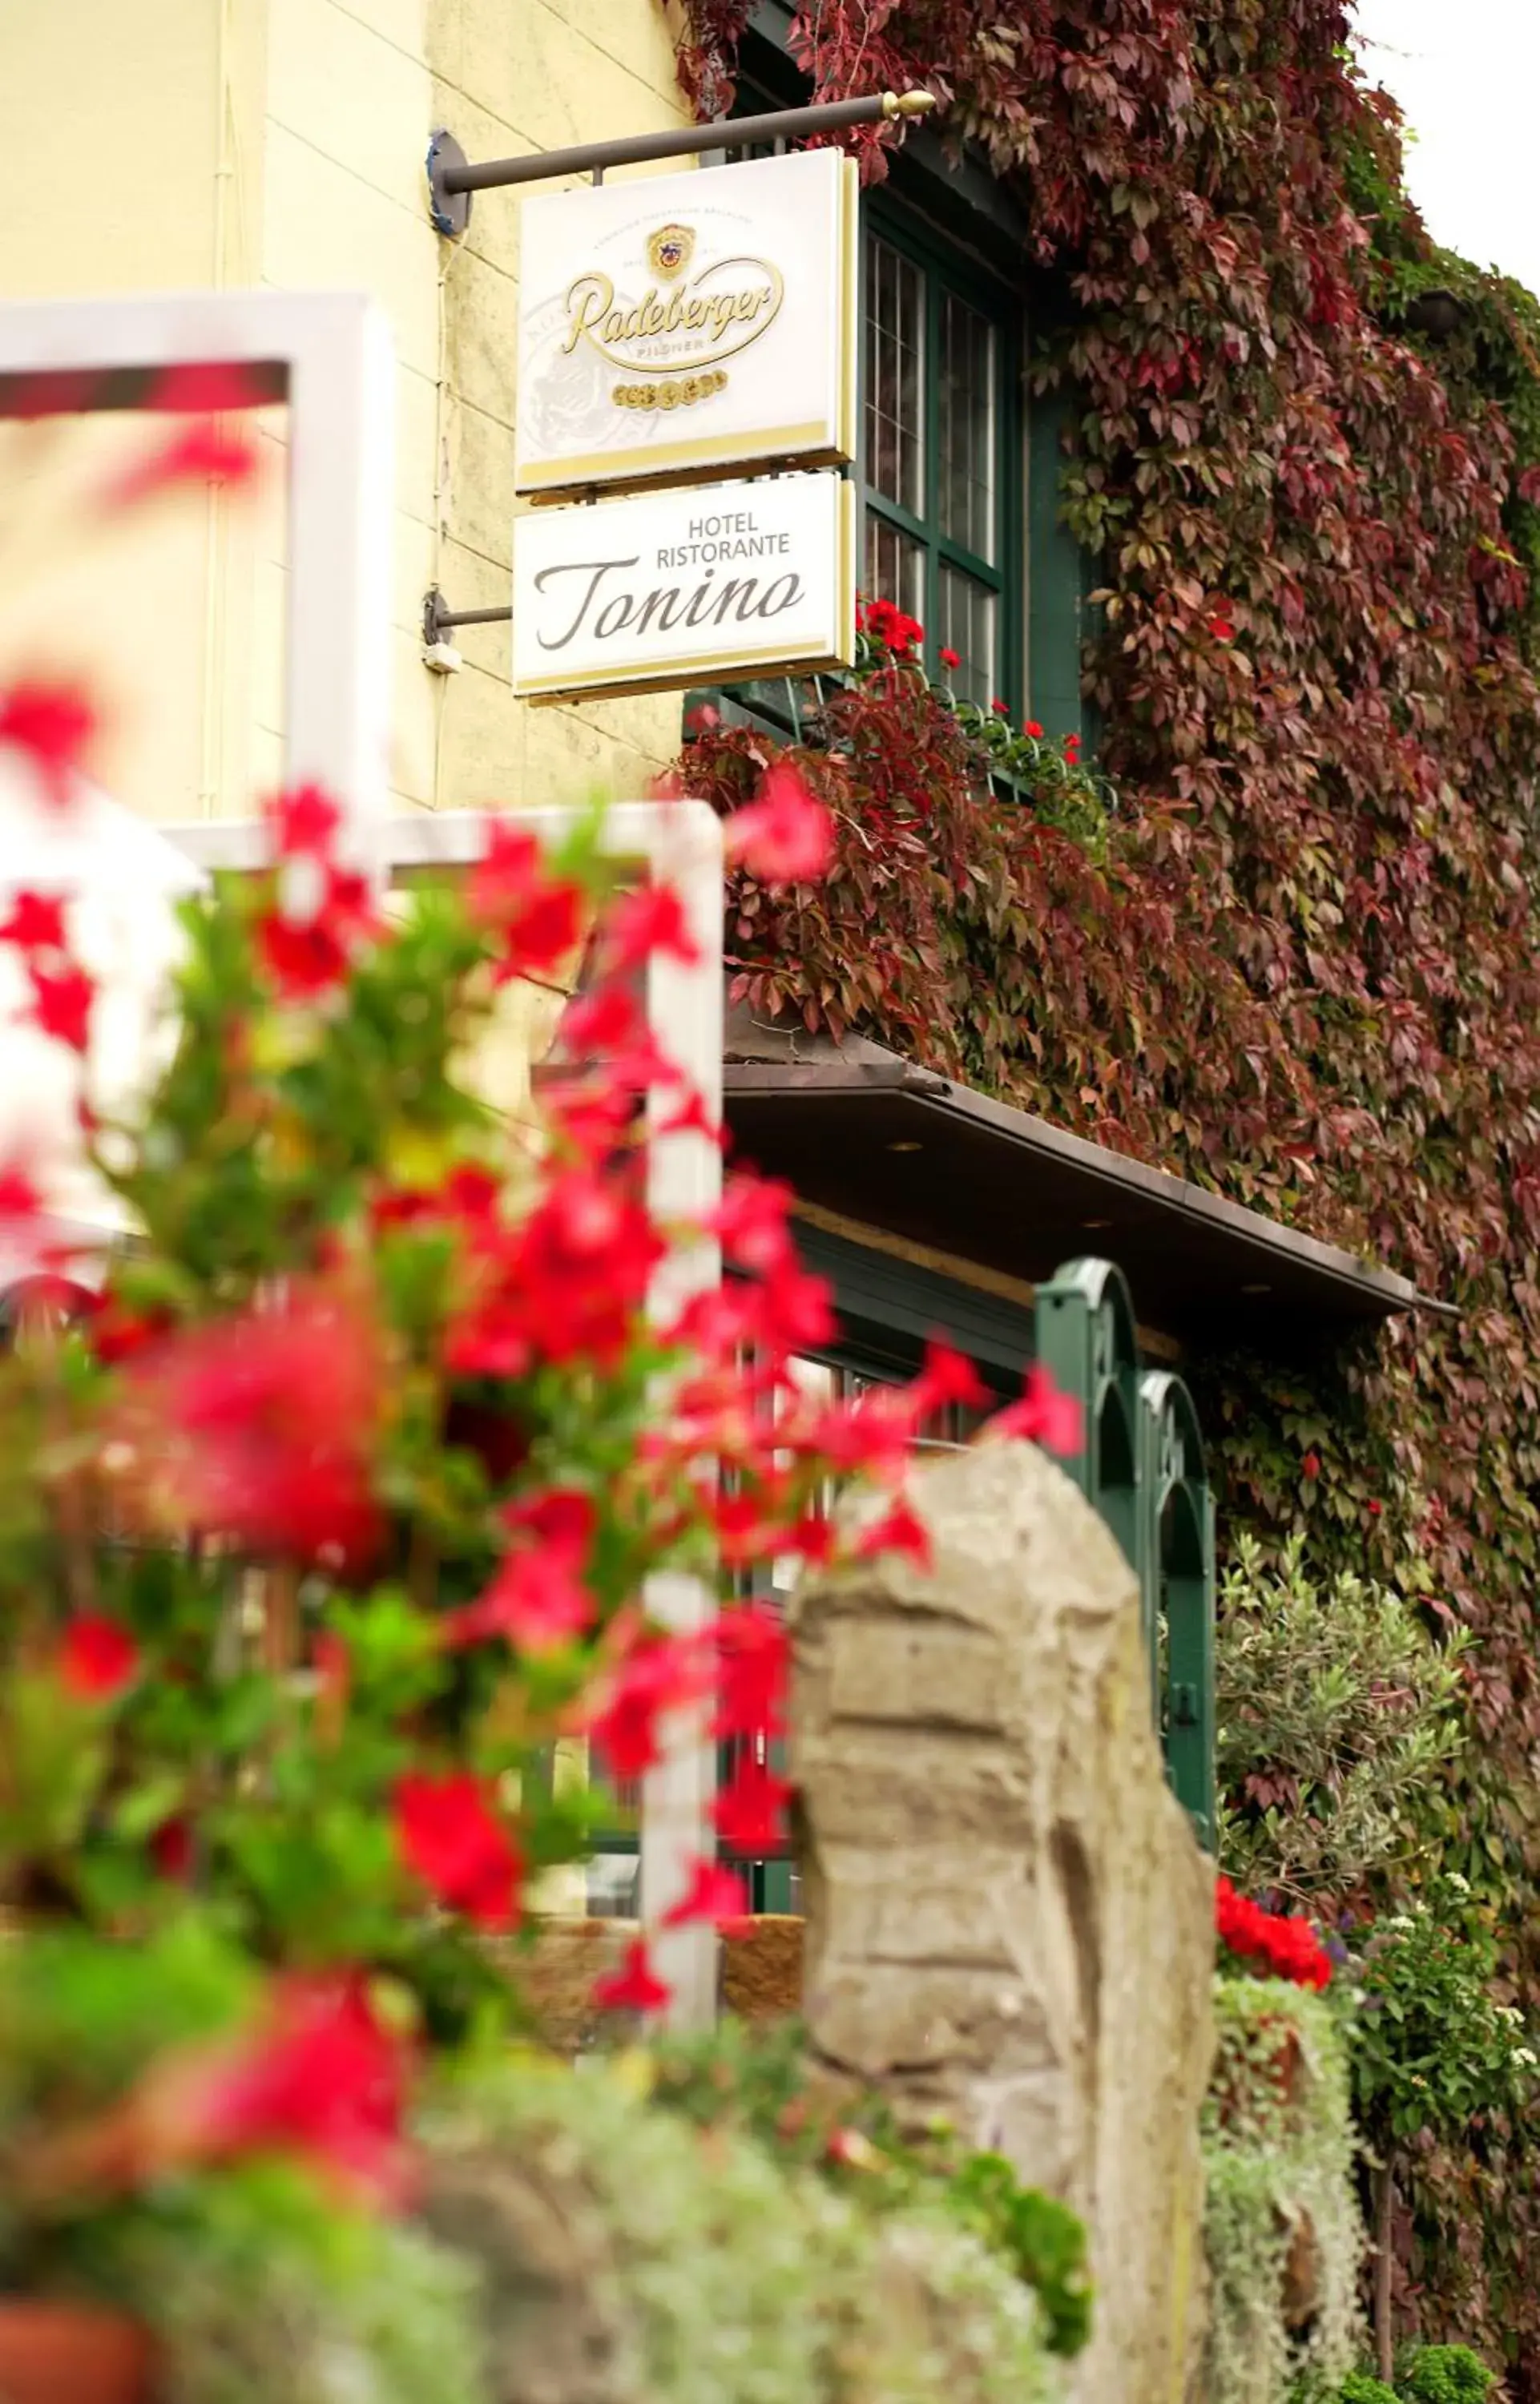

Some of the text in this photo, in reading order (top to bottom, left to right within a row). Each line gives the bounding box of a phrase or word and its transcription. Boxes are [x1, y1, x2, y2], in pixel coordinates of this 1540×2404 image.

[562, 269, 772, 354] Radeberger
[635, 339, 705, 358] PILSNER
[689, 512, 758, 538] HOTEL
[657, 533, 790, 570] RISTORANTE
[534, 555, 806, 651] Tonino
